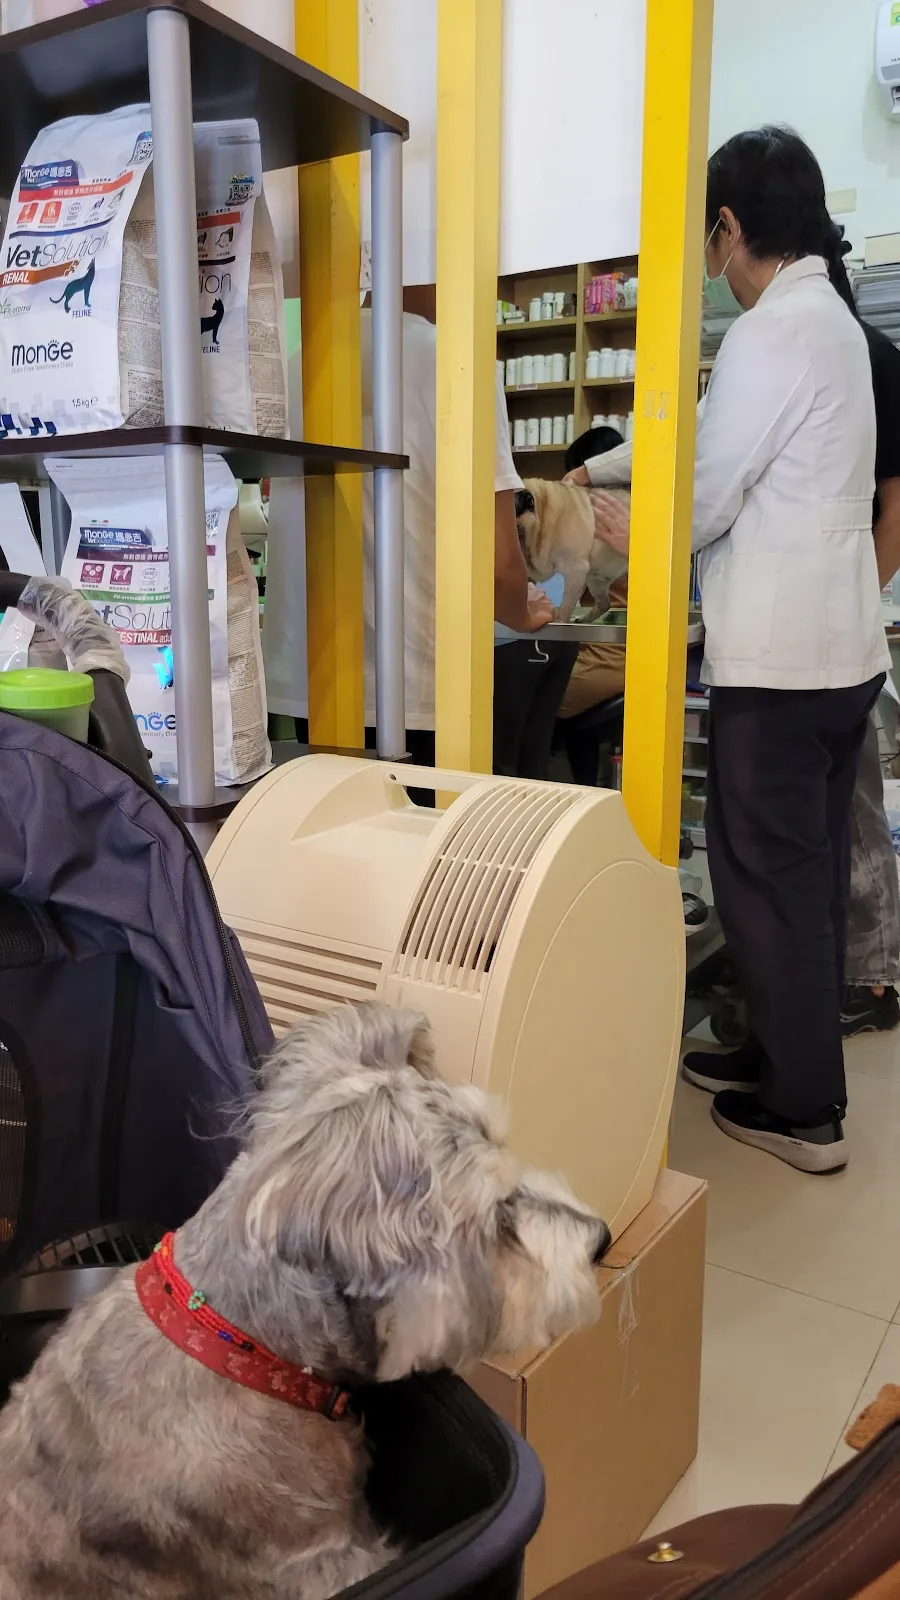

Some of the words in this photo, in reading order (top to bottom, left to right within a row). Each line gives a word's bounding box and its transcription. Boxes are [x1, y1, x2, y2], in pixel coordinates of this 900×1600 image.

[6, 231, 109, 269] VetSolution
[2, 271, 29, 285] RENAL
[72, 308, 92, 317] FELINE
[120, 632, 158, 644] ESTINAL
